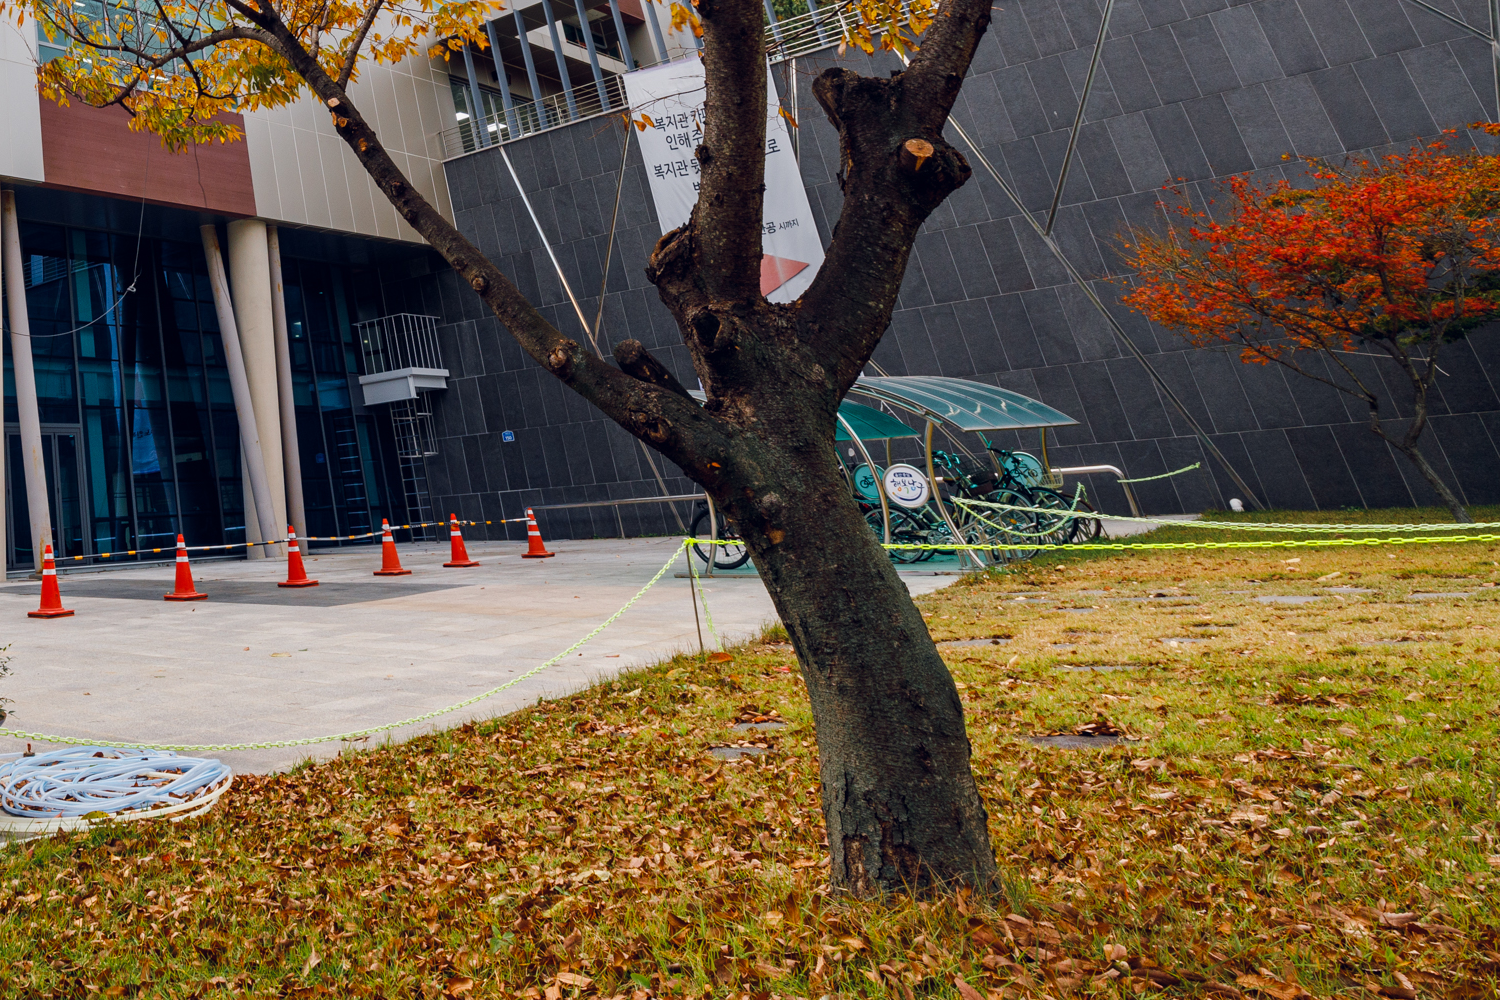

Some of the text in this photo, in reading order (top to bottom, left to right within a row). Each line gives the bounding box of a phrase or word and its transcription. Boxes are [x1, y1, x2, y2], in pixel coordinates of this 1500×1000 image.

[654, 112, 689, 132] 복지관
[666, 132, 691, 150] 인해
[654, 160, 689, 180] 복지관
[778, 218, 799, 230] 시까지
